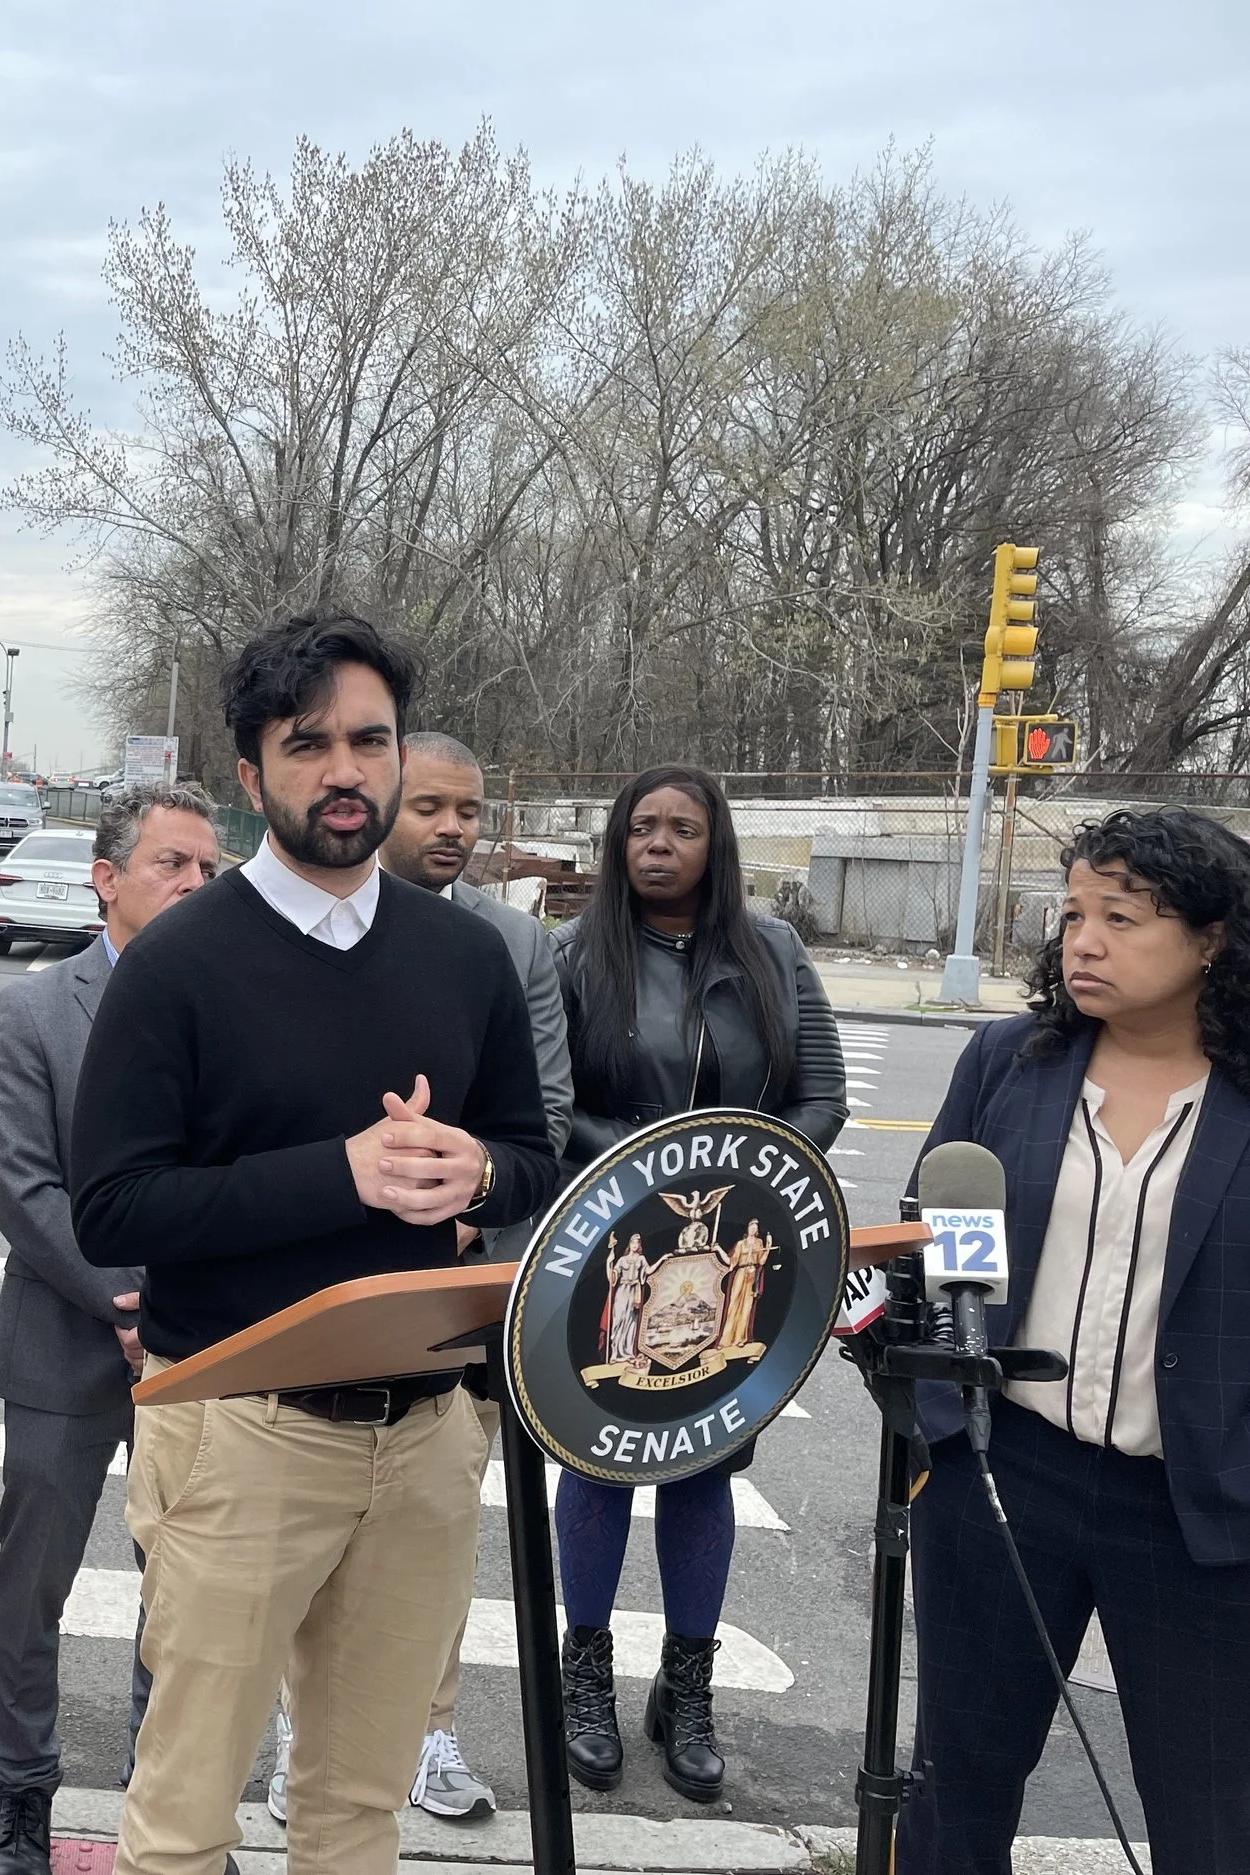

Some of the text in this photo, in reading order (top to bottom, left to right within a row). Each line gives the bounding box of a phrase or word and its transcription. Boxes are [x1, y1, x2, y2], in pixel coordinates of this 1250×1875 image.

[544, 1133, 830, 1278] NEW YORK STATE
[932, 1214, 994, 1229] news
[933, 1230, 998, 1272] 12
[844, 1267, 873, 1311] AP
[636, 1366, 710, 1388] EXCELSIOR
[590, 1398, 746, 1463] SENATE
